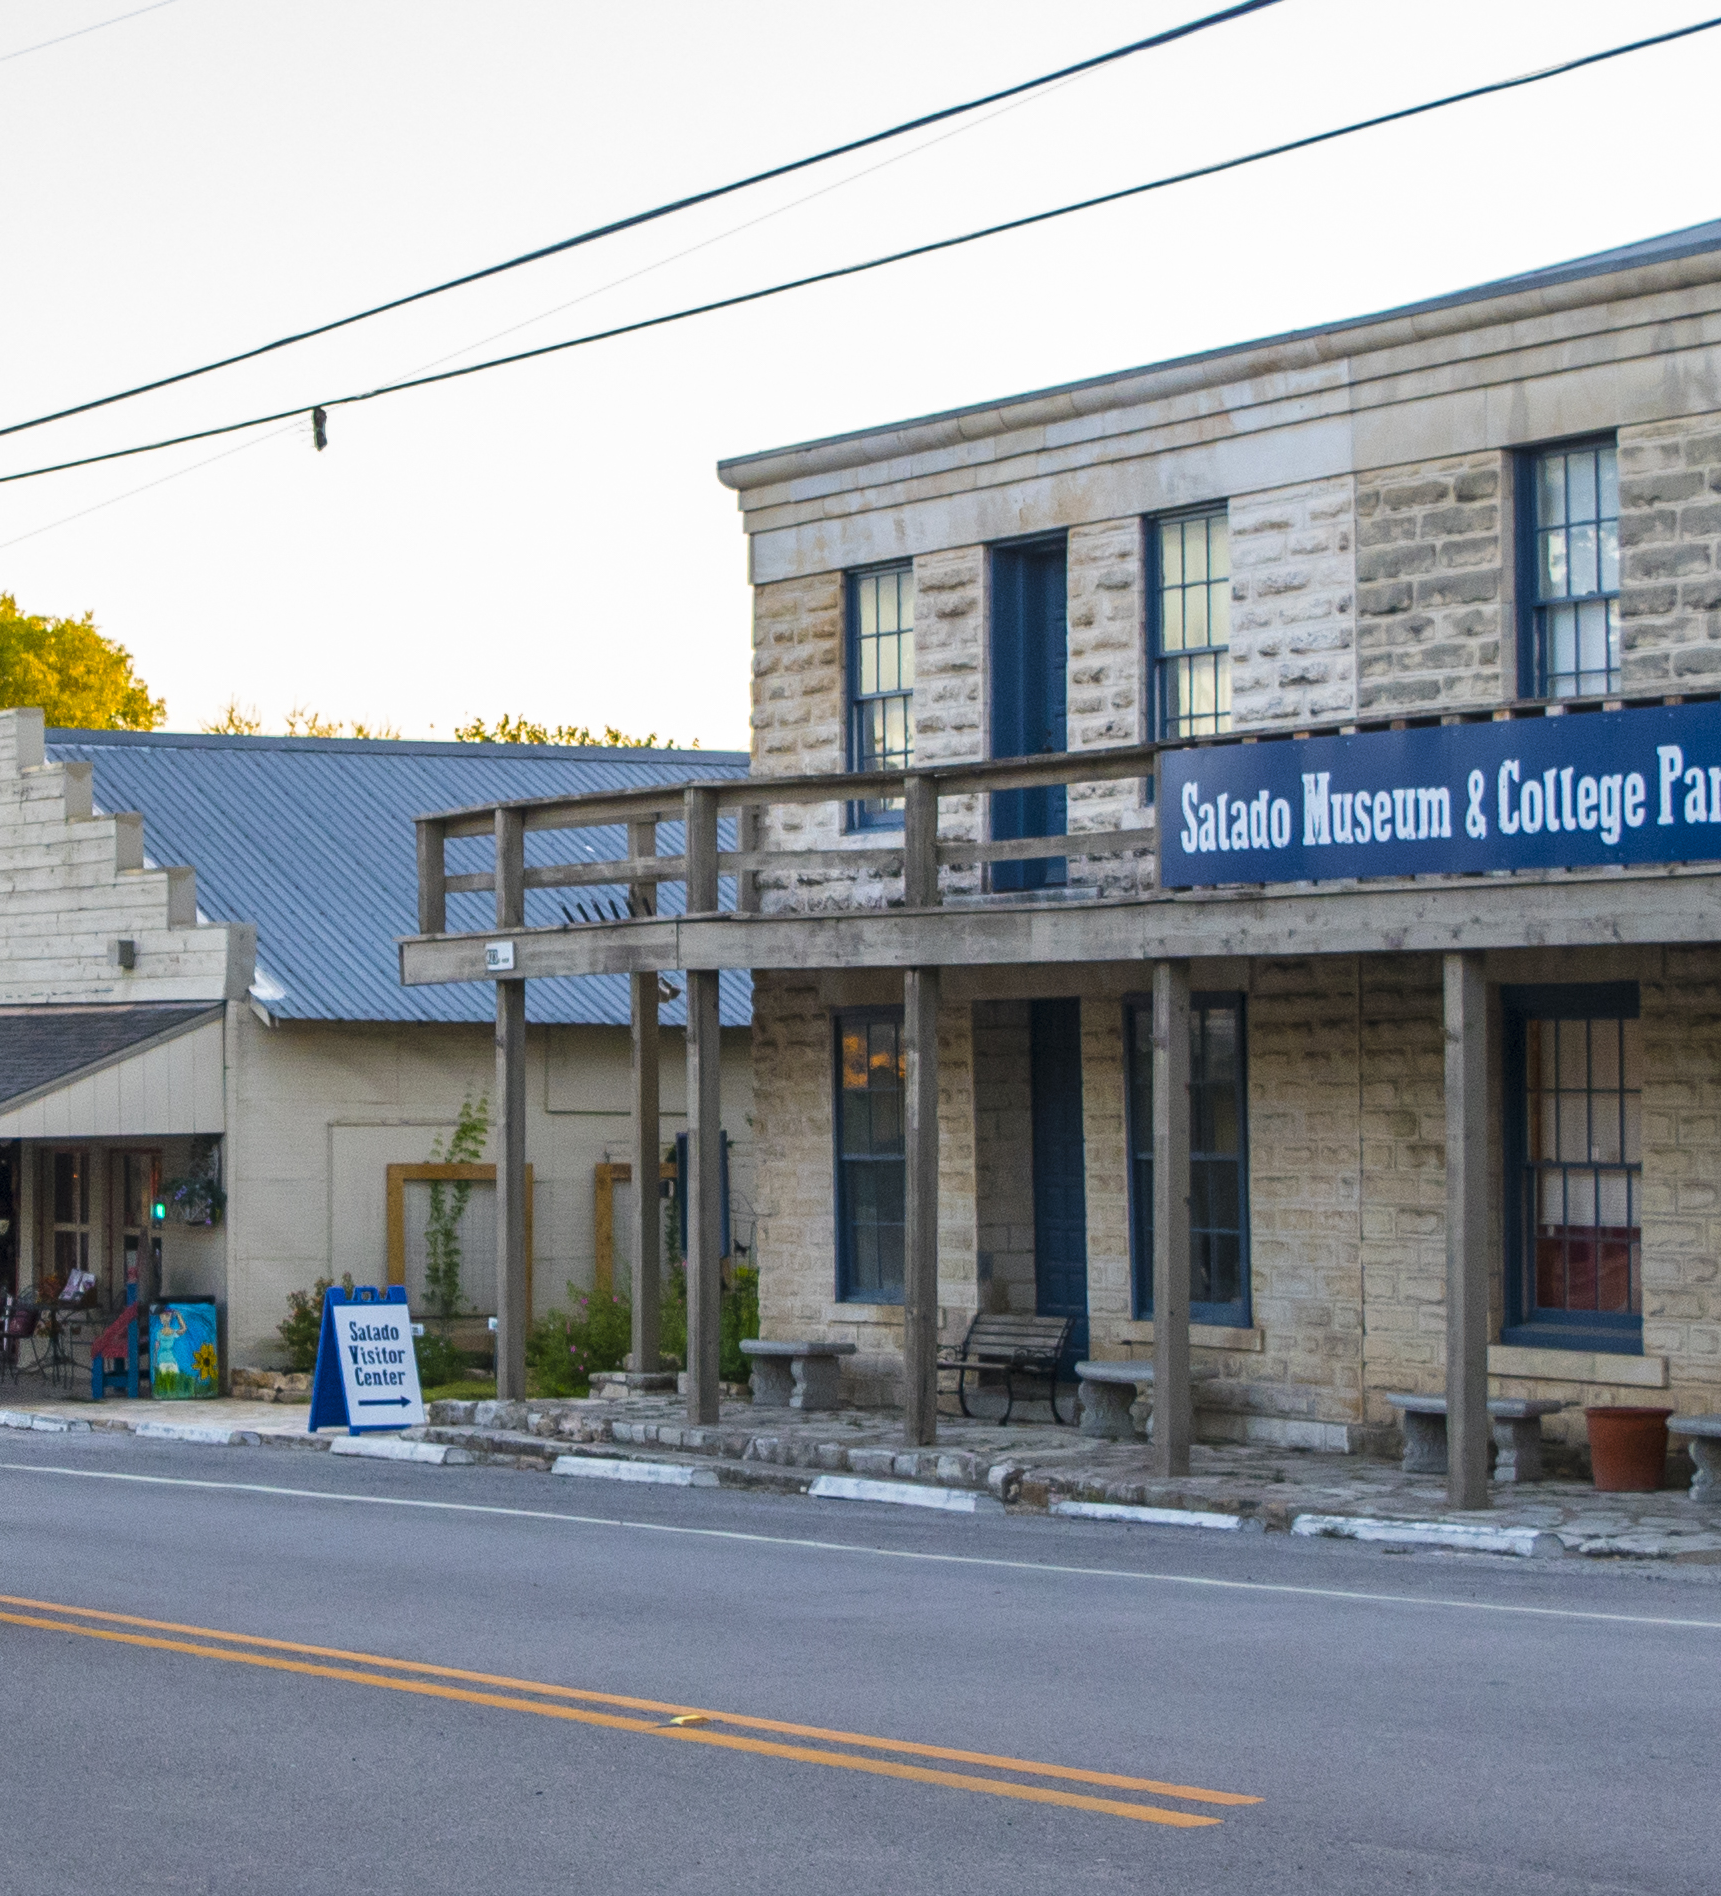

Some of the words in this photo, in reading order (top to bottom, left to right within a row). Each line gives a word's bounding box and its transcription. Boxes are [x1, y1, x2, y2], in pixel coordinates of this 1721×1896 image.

[1180, 781, 1291, 853] Salado
[1302, 772, 1451, 846] Museum
[1465, 769, 1487, 839] &
[1498, 758, 1647, 845] College
[349, 1320, 400, 1342] Salado
[348, 1345, 406, 1365] Visitor
[354, 1366, 406, 1387] Center
